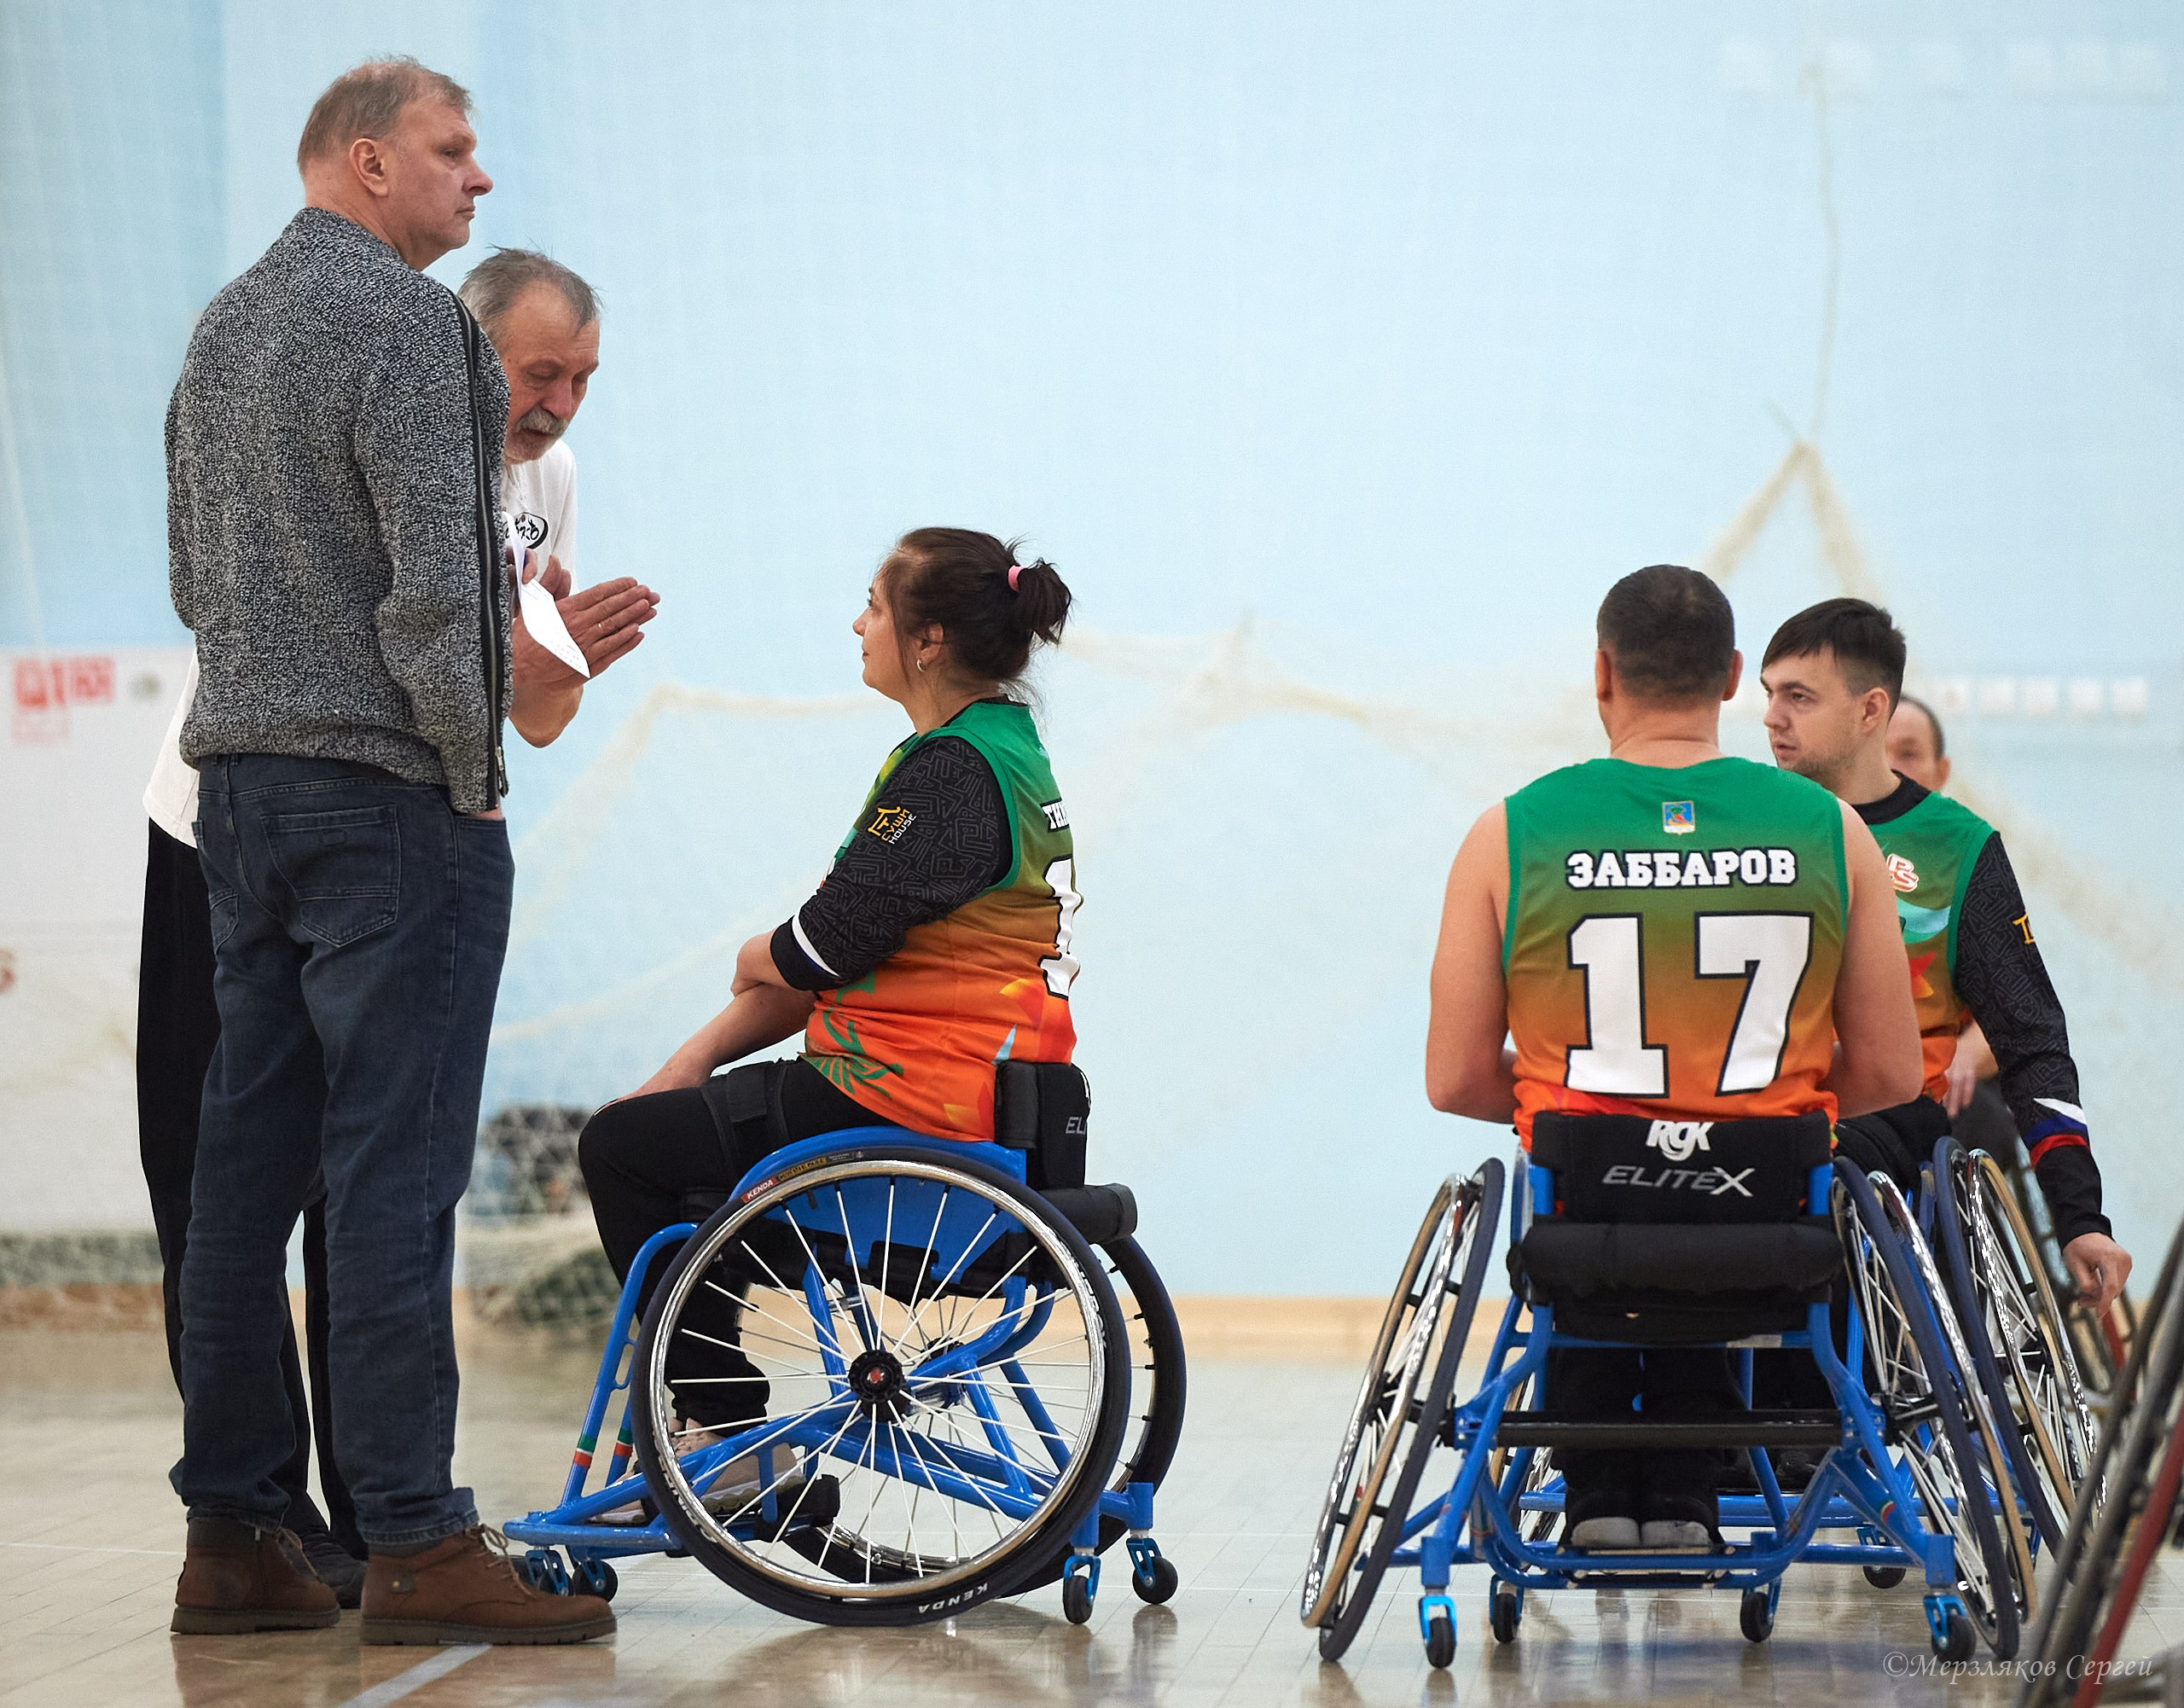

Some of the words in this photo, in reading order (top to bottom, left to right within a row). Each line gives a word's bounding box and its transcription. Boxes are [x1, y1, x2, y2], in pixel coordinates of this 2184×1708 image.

[888, 813, 917, 845] HOUSE
[1565, 848, 1797, 888] ЗАББАРОВ
[1566, 911, 1814, 1097] 17
[746, 1179, 774, 1200] KENDA
[1602, 1165, 1756, 1197] ELITEX
[918, 1583, 988, 1614] KENDA
